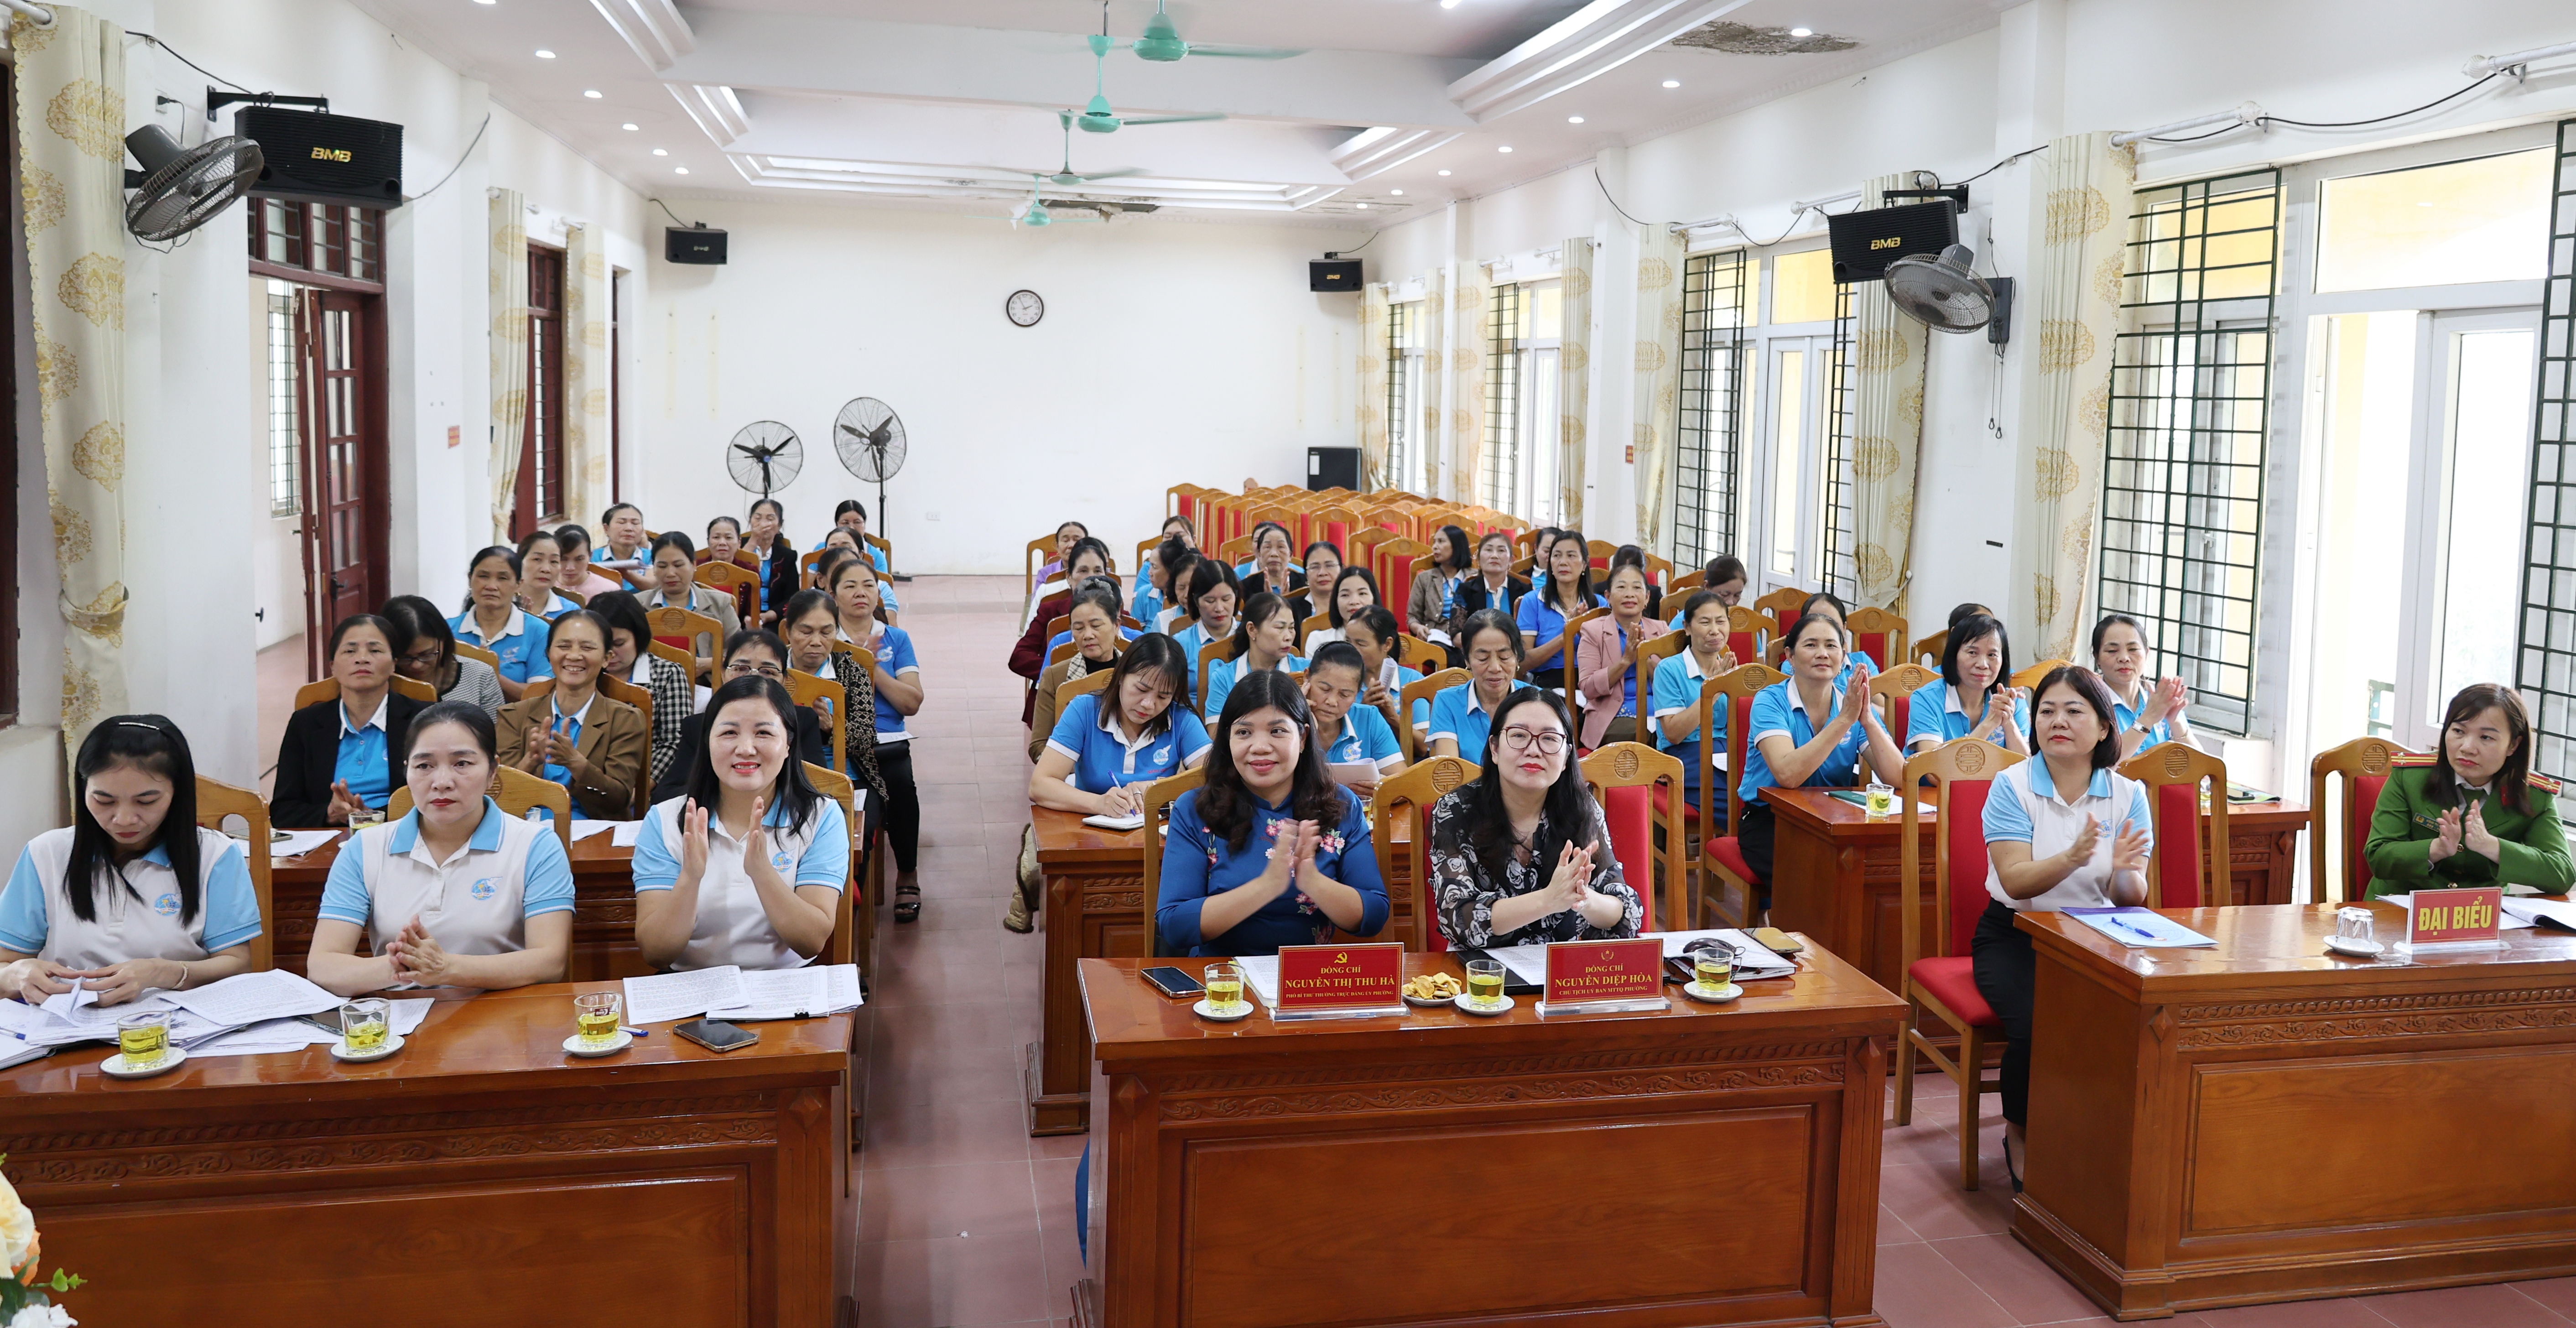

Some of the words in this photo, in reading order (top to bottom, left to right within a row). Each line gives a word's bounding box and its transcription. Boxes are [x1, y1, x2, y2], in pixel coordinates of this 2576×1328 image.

[311, 147, 352, 162] BMB
[1871, 237, 1901, 250] BMB
[2419, 907, 2448, 935] ĐẠI
[2452, 896, 2492, 929] BIỂU
[1321, 965, 1344, 974] ĐỒNG
[1346, 964, 1361, 973] CHÍ
[1585, 965, 1608, 973] ĐỒNG
[1609, 963, 1623, 972] CHÍ
[1285, 977, 1330, 988] NGUYỄN
[1333, 978, 1352, 988] THỊ
[1354, 977, 1377, 986] THU
[1380, 974, 1395, 985] HÀ
[1555, 975, 1599, 987] NGUYỄN
[1603, 974, 1627, 986] DIỆP
[1629, 972, 1652, 983] HÒA
